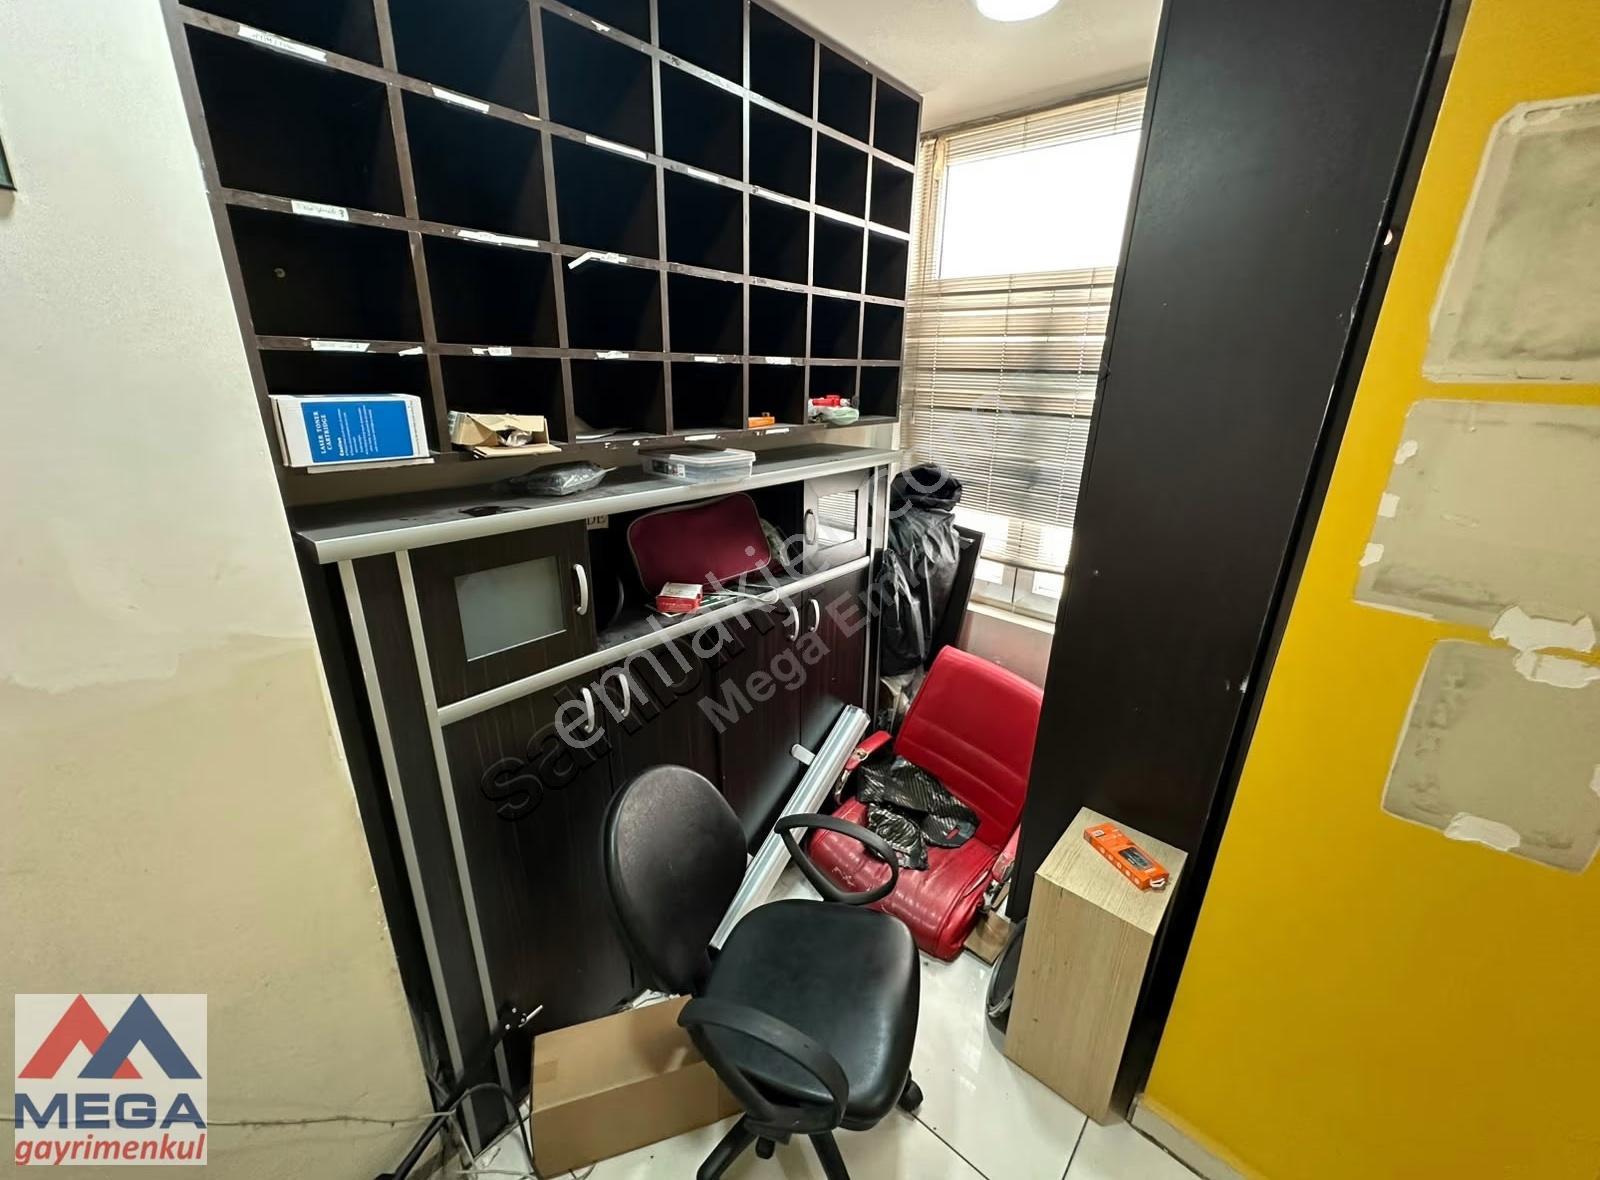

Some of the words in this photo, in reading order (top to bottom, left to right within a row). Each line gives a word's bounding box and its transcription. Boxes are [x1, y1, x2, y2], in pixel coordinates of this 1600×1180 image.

[313, 410, 322, 433] TONER
[320, 414, 333, 451] CARTRIDGE
[318, 435, 327, 454] LASER
